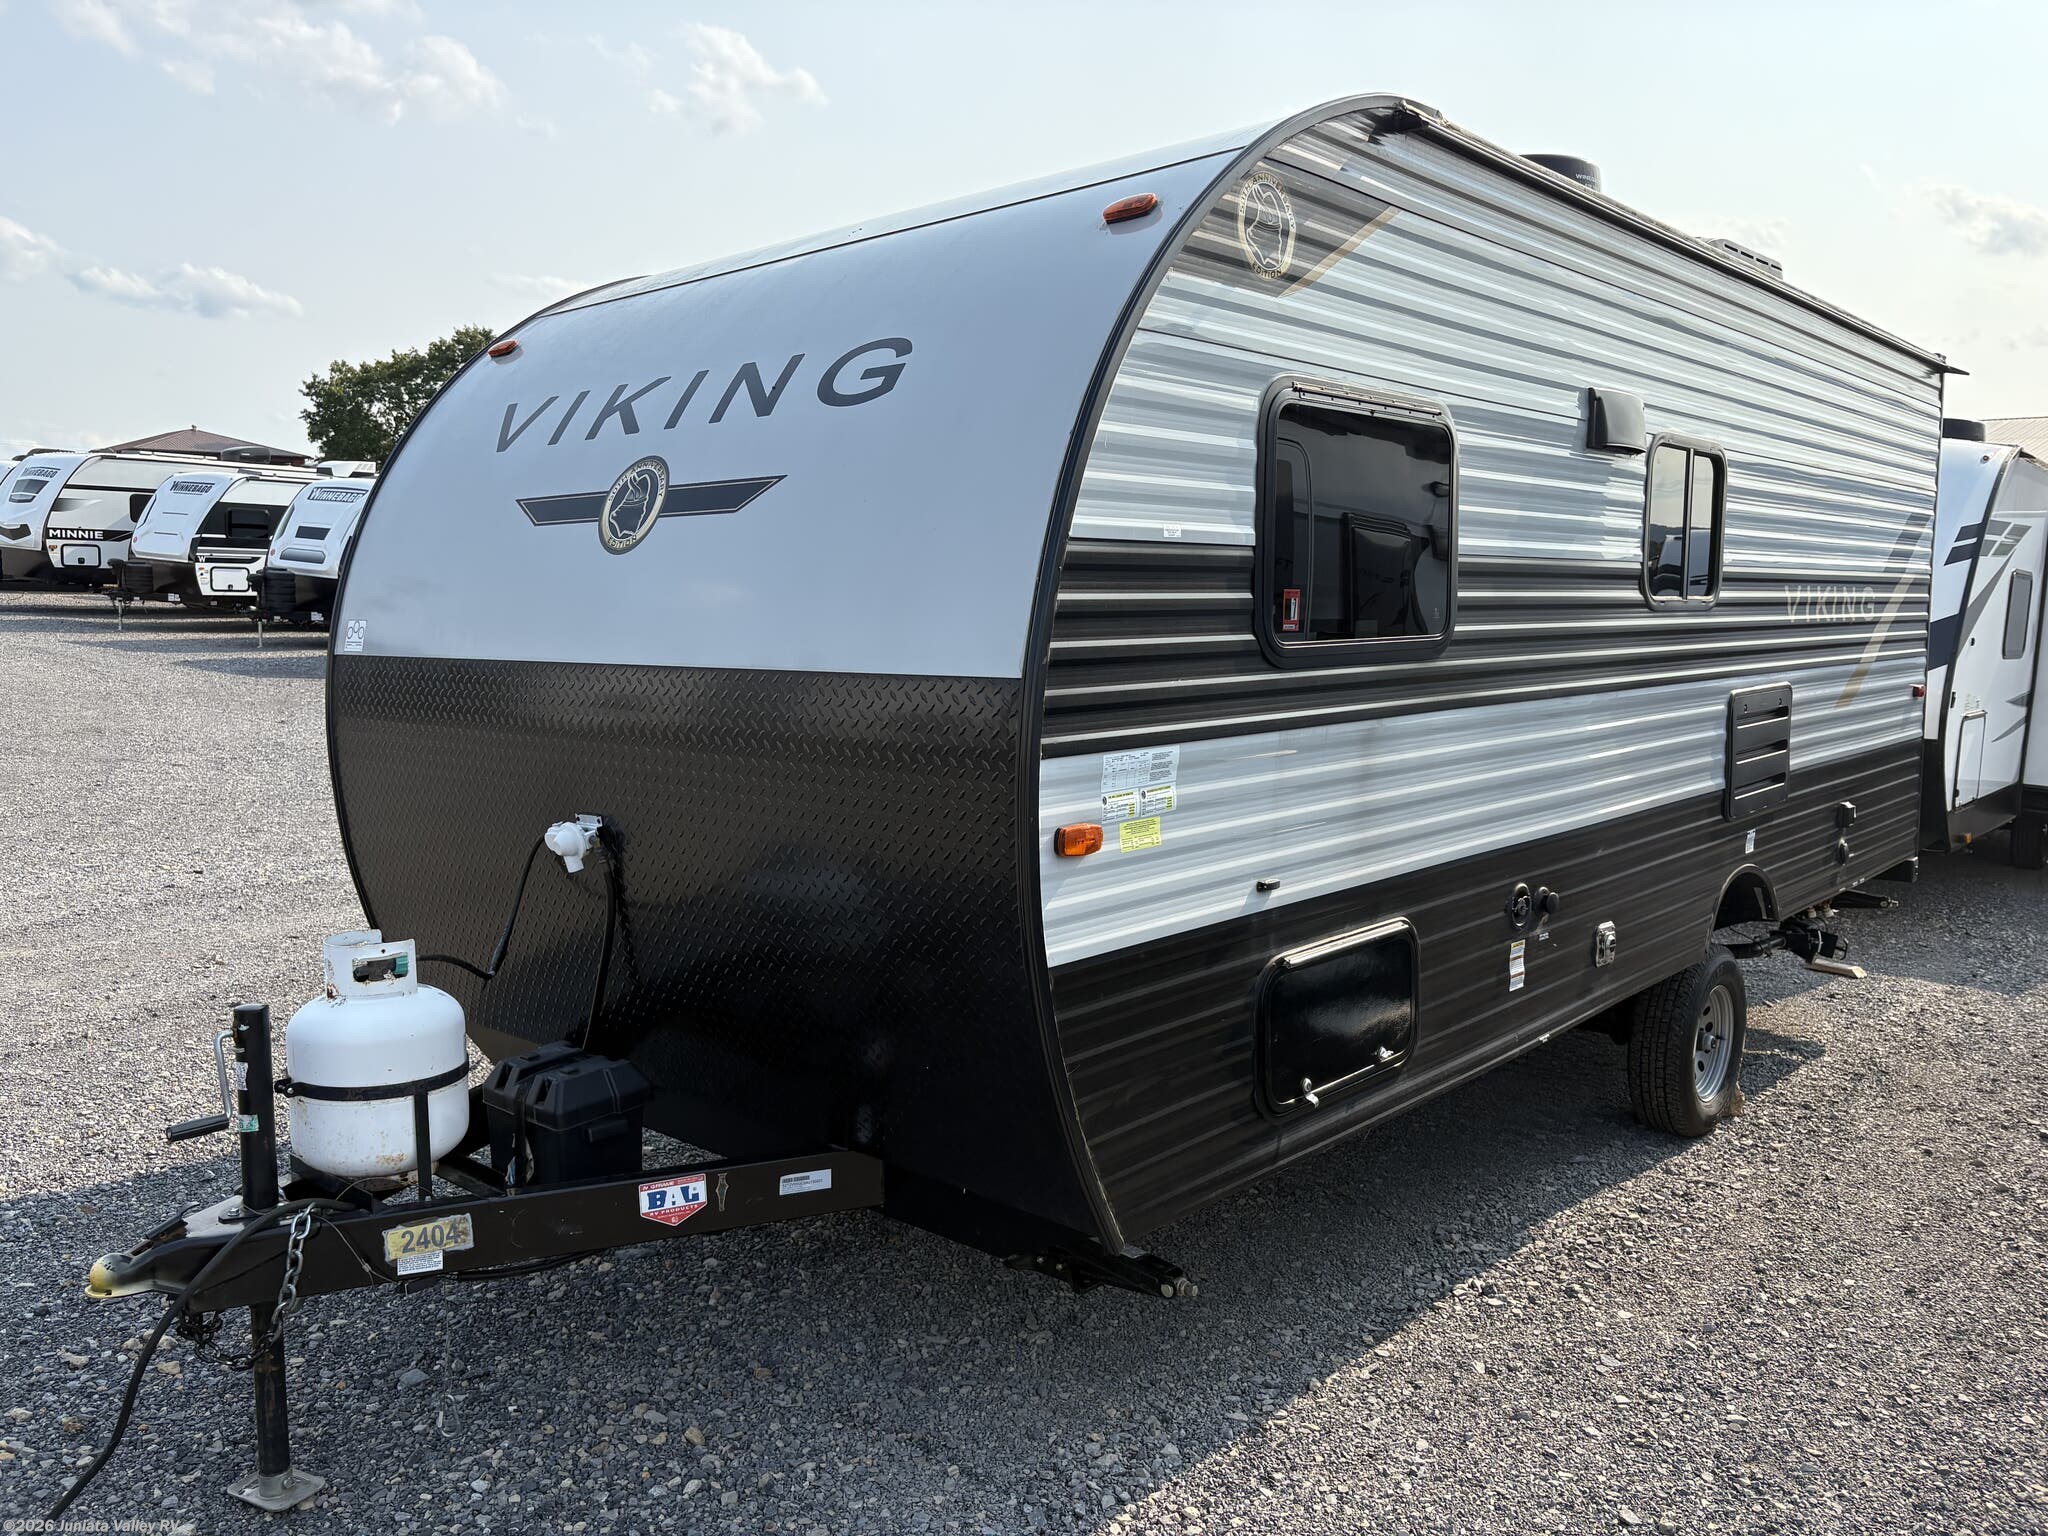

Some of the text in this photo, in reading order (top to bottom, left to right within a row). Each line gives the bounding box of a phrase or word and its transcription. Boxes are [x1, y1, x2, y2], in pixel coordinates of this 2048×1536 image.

[1252, 263, 1282, 279] EDITION
[496, 337, 913, 453] VIKING
[170, 481, 214, 494] WINNEBAGO
[49, 528, 104, 539] MINNIE
[1784, 585, 1876, 623] VIKING
[647, 1185, 700, 1210] BAL
[661, 1205, 699, 1215] PRODUCTS
[401, 1221, 460, 1254] 2404
